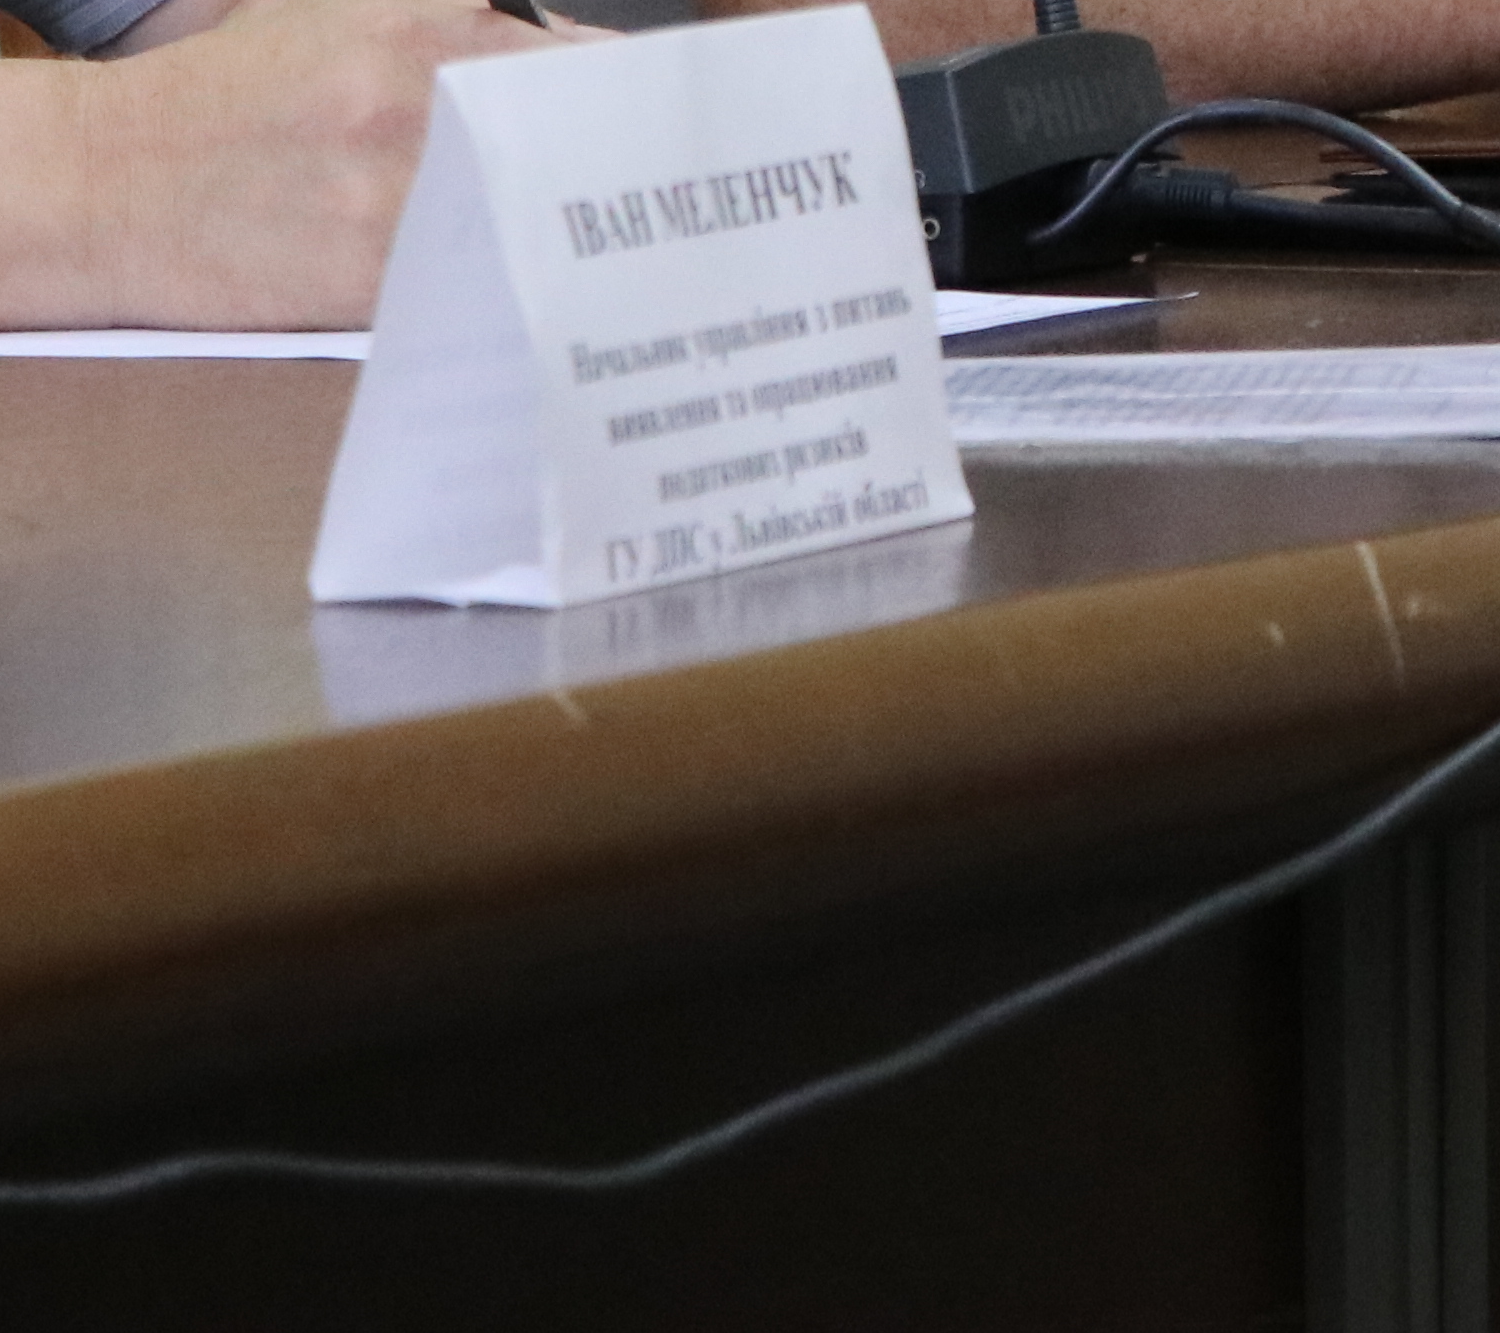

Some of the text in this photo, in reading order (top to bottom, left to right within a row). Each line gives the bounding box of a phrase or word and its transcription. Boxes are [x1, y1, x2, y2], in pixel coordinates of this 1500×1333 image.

[563, 151, 858, 259] ІВАН МЕЛЕНЧУК
[606, 536, 641, 582] ГУ
[652, 520, 706, 575] ДПС
